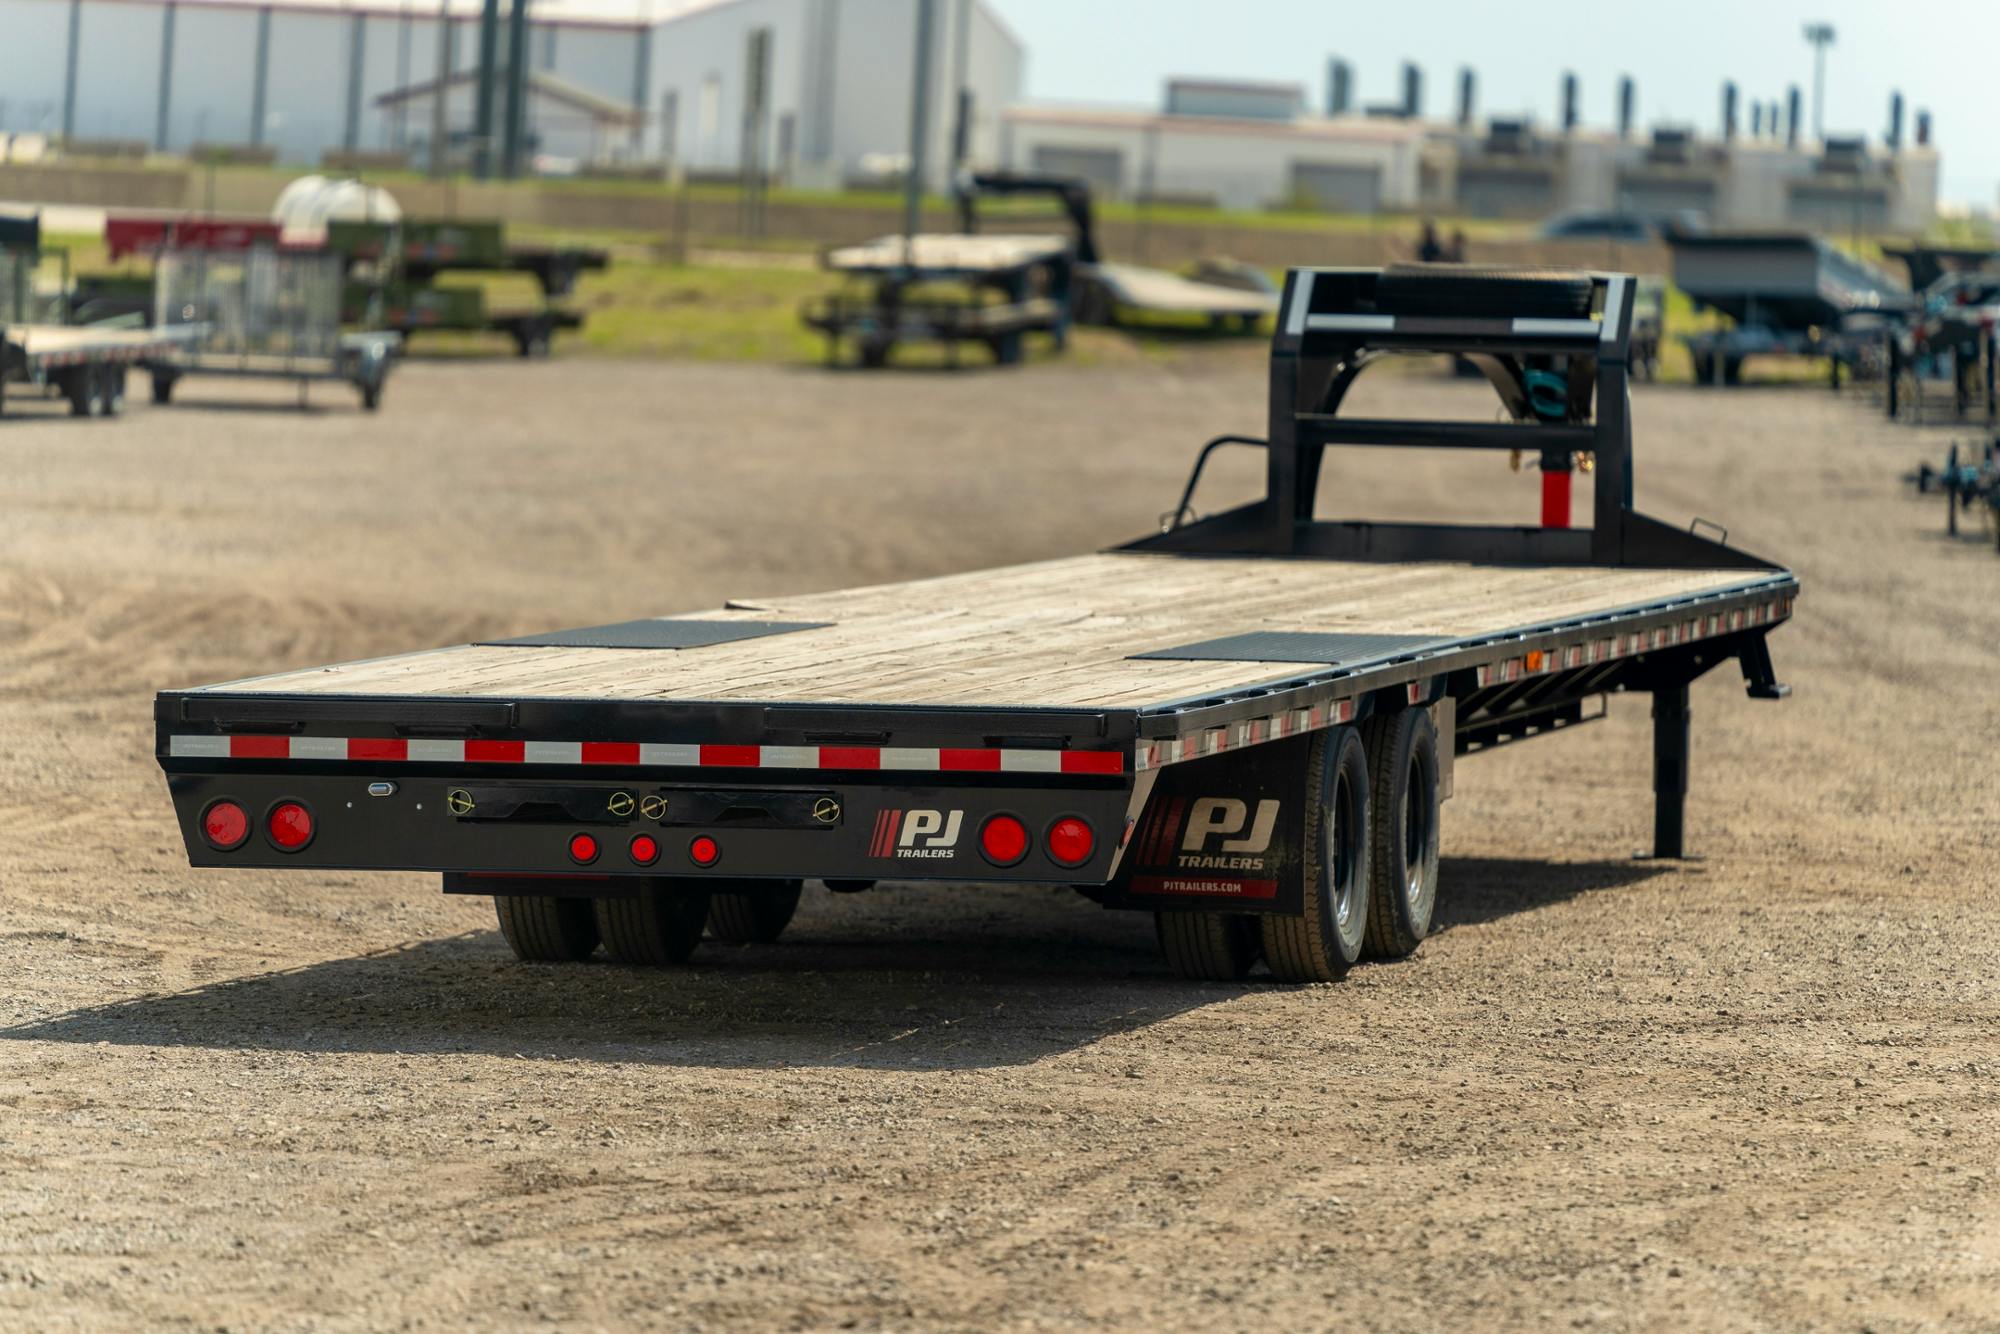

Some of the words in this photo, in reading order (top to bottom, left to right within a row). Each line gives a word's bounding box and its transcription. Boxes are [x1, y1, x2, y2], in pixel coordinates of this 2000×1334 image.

[899, 809, 964, 847] PJ
[1181, 797, 1281, 853] PJ
[897, 849, 954, 858] TRAILERS
[1178, 855, 1265, 870] TRAILERS
[1163, 880, 1242, 893] PJTRAILERS.COM
